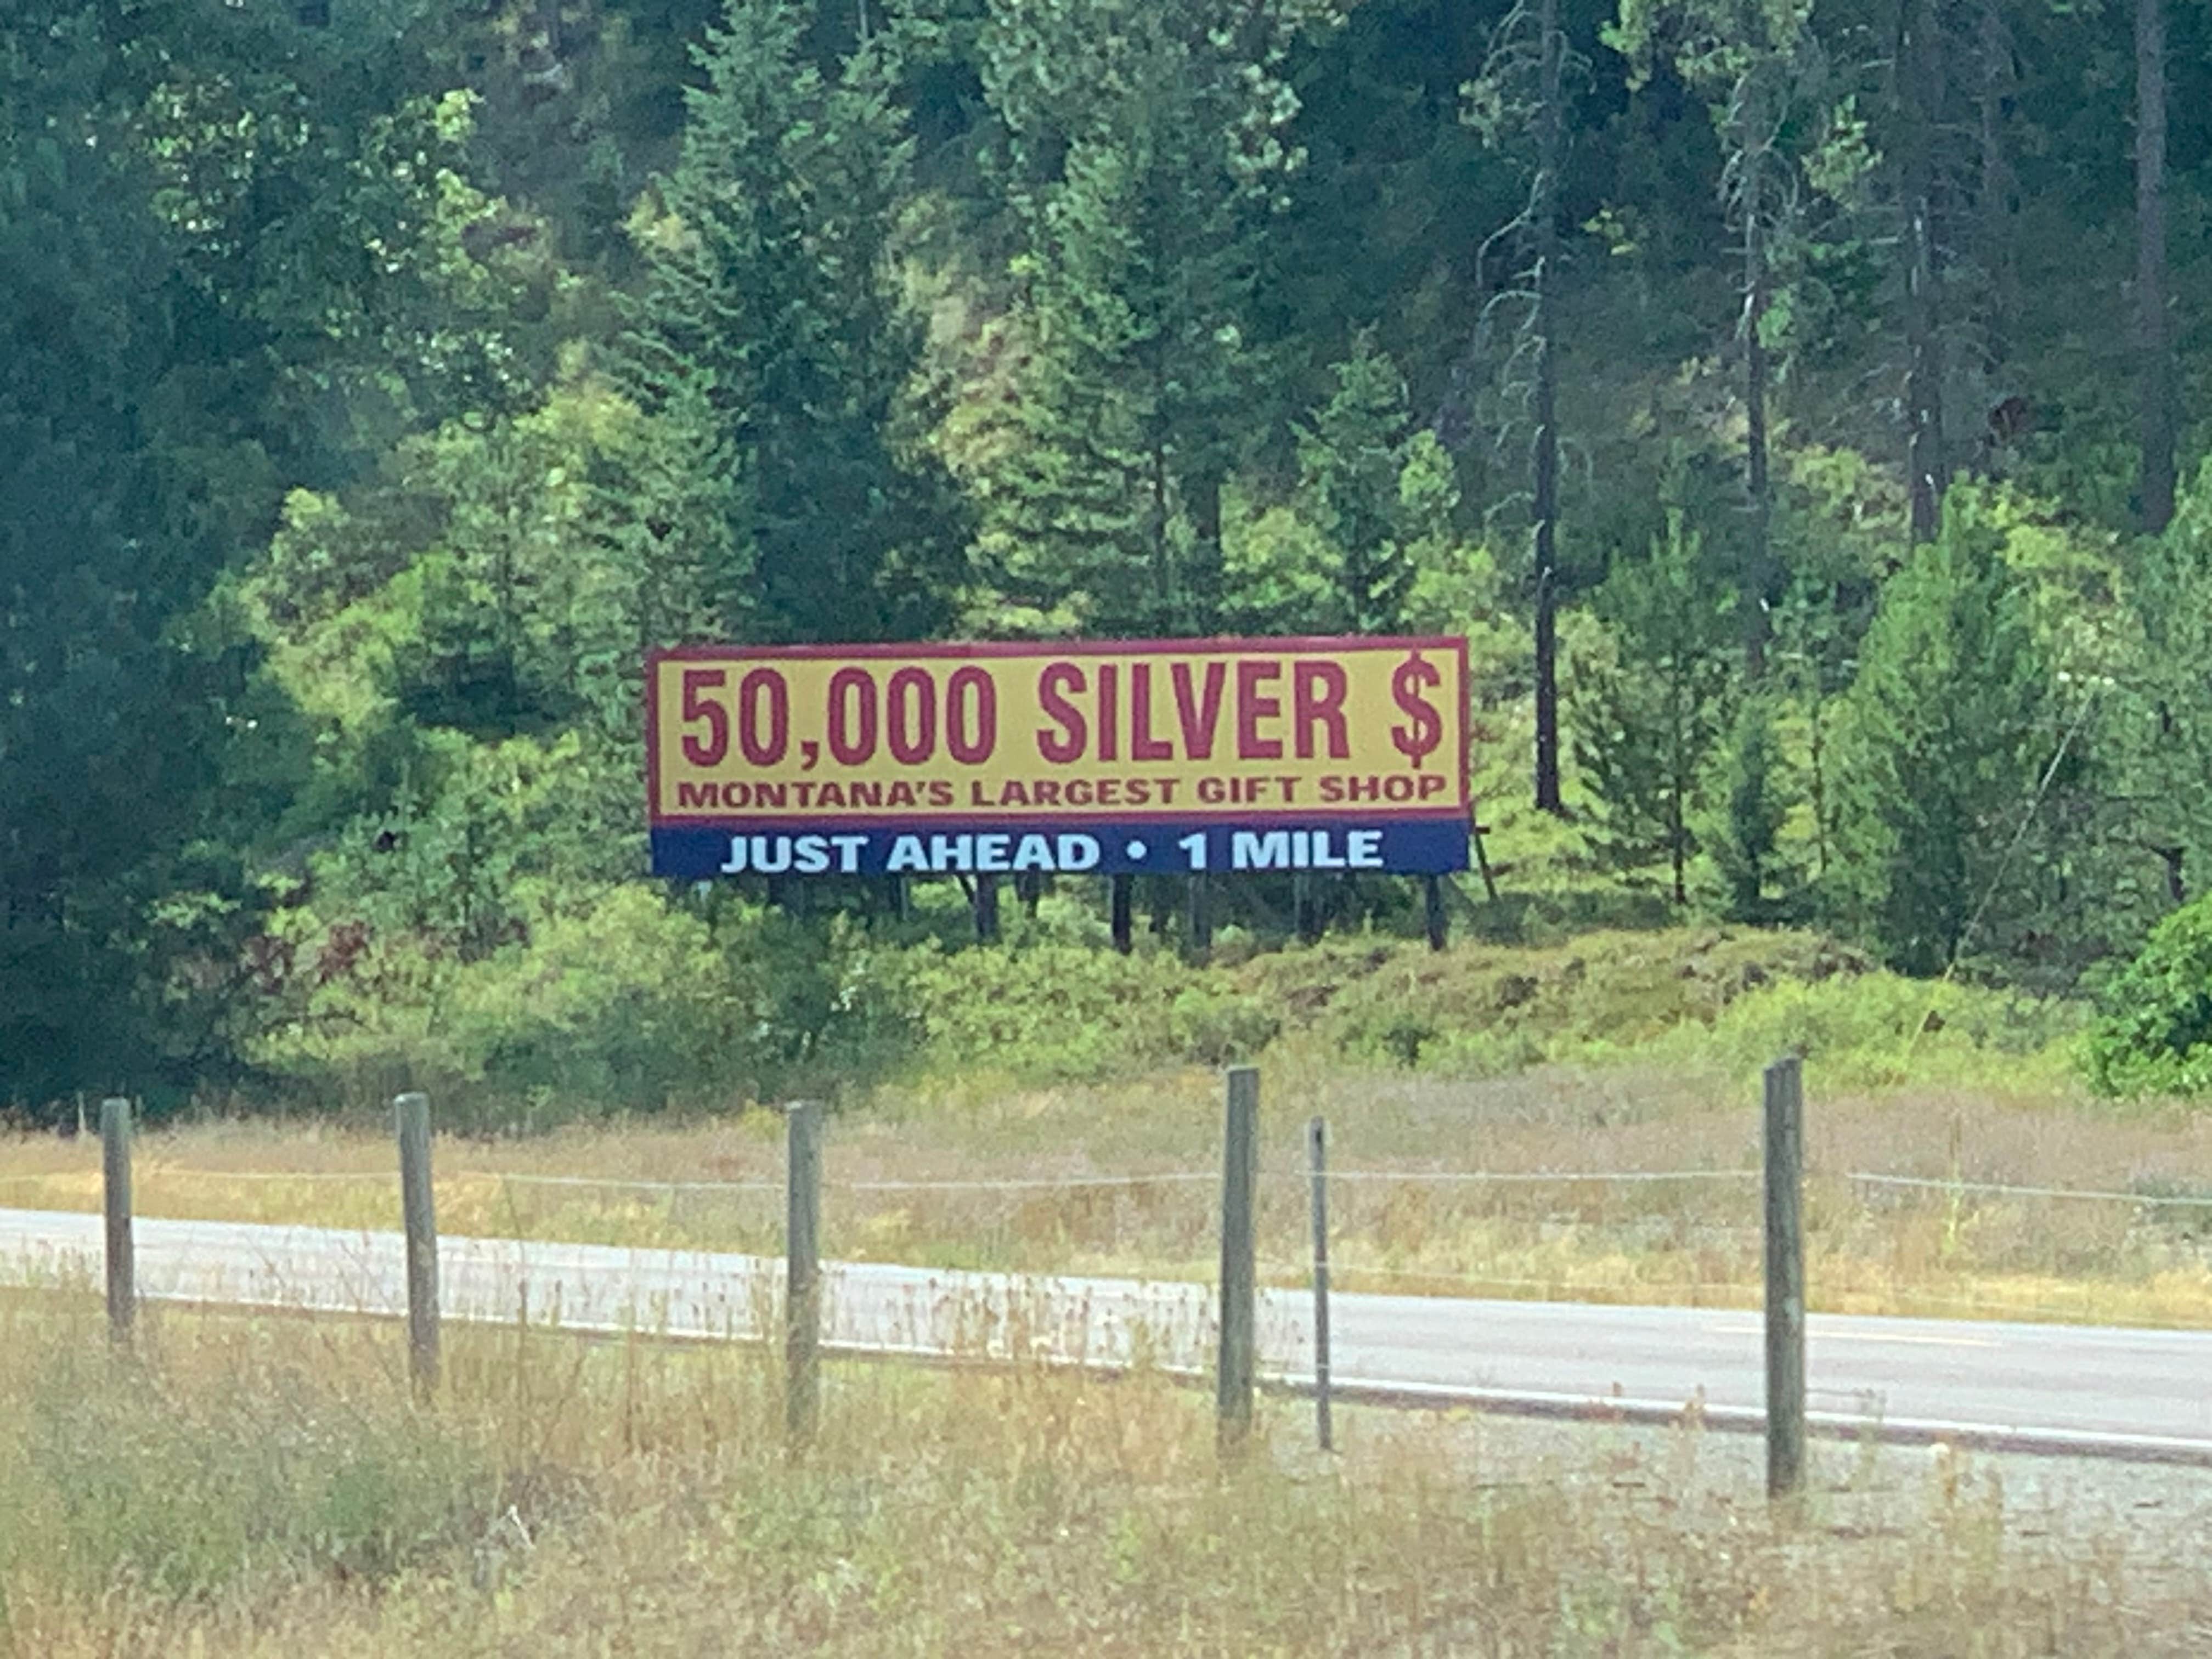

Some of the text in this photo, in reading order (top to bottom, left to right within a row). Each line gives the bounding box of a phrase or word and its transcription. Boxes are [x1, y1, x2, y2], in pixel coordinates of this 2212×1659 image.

[681, 648, 1443, 771] 50,000 SILVER $
[677, 774, 1447, 808] MONTANA'S LARGEST GIFT SHOP
[720, 830, 1384, 873] JUST AHEAD 1 MILE
